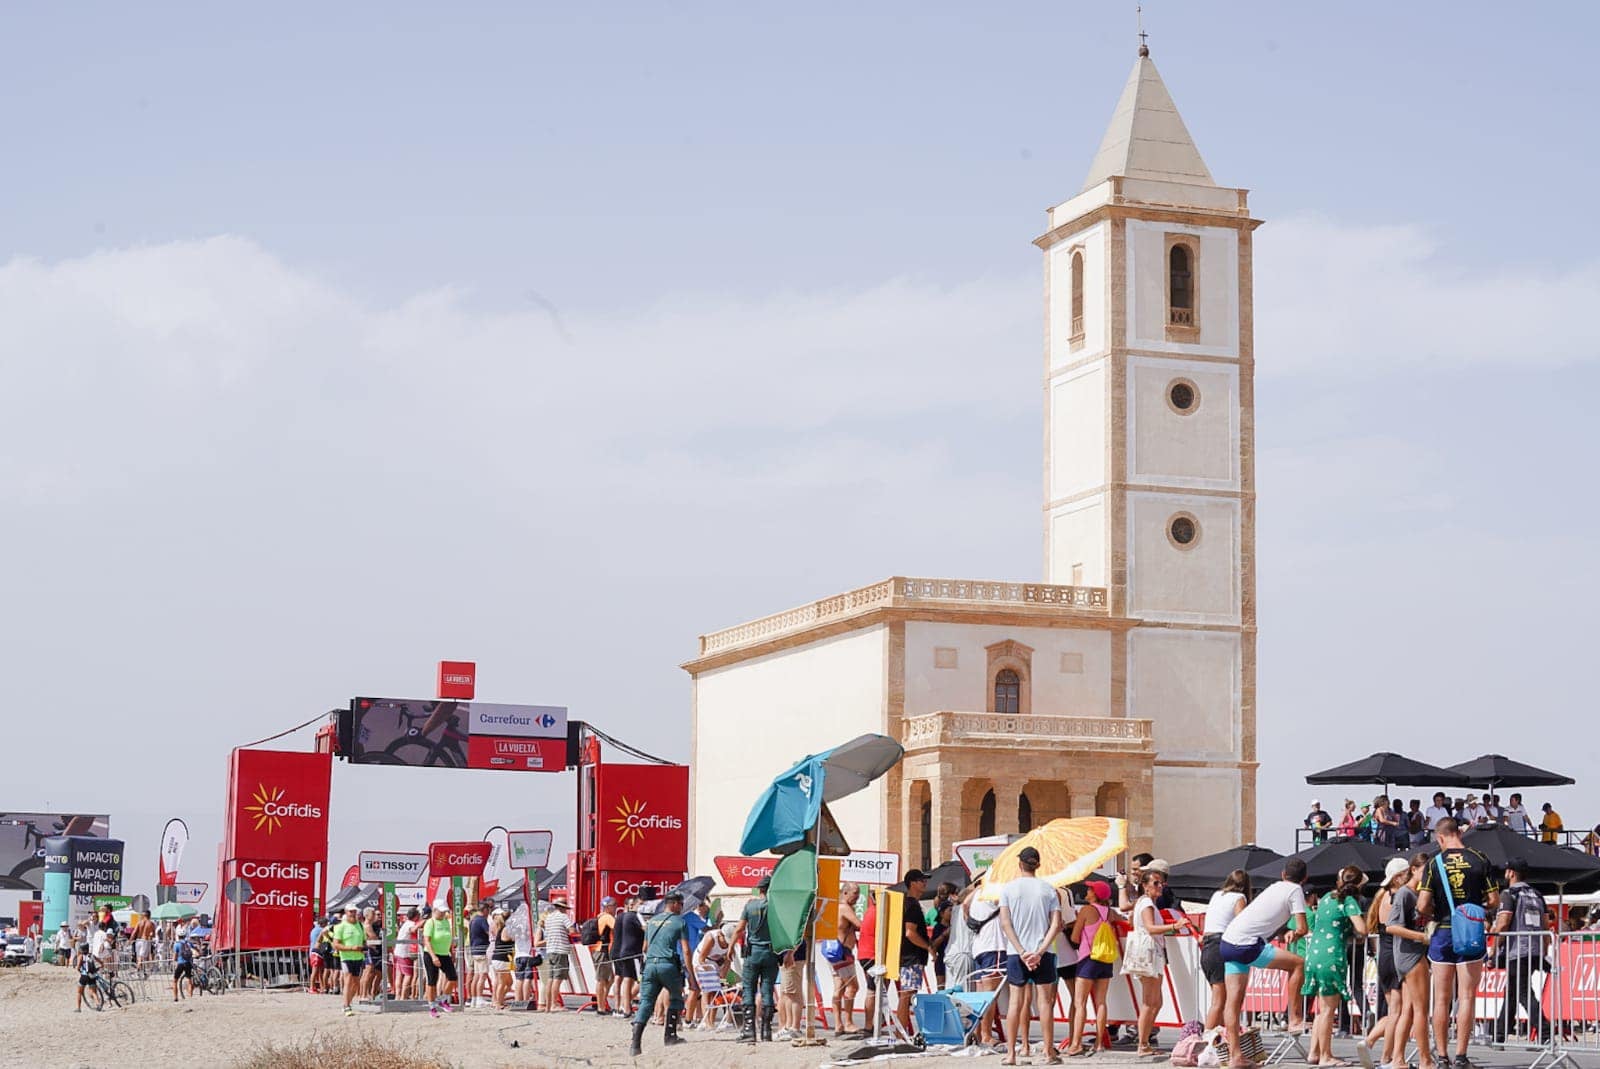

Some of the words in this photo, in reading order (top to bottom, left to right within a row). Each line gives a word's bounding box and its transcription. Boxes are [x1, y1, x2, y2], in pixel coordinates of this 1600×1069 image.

[480, 713, 531, 725] Carrefour
[499, 743, 507, 752] LA
[509, 743, 536, 753] VUELTA
[264, 803, 321, 818] Cofidis
[627, 815, 682, 829] Cofidis
[448, 853, 483, 865] Cofidis
[847, 859, 893, 870] TISSOT
[241, 862, 310, 879] Cofidis
[381, 861, 420, 870] TISSOT
[73, 881, 120, 893] Fertiberia
